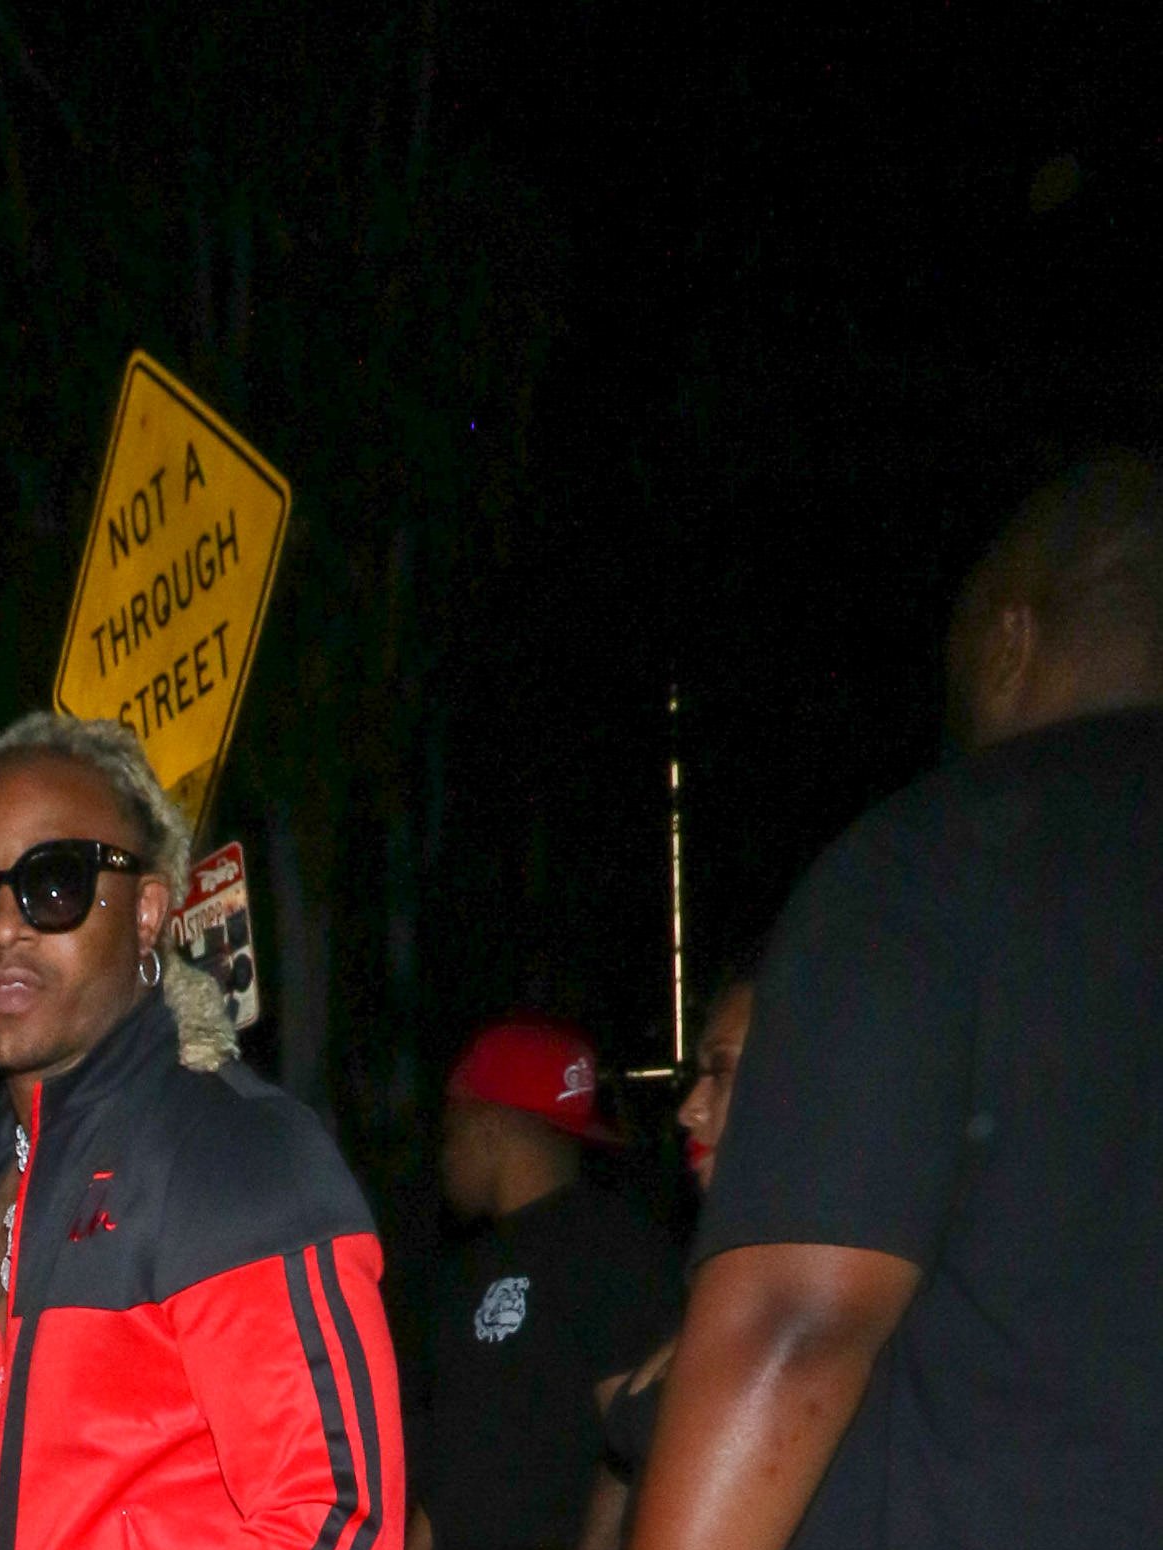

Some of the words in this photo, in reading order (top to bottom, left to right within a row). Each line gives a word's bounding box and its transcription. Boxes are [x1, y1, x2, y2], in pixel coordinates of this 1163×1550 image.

[107, 468, 166, 568] NOT
[184, 441, 206, 503] A
[91, 510, 239, 677] THROUGH
